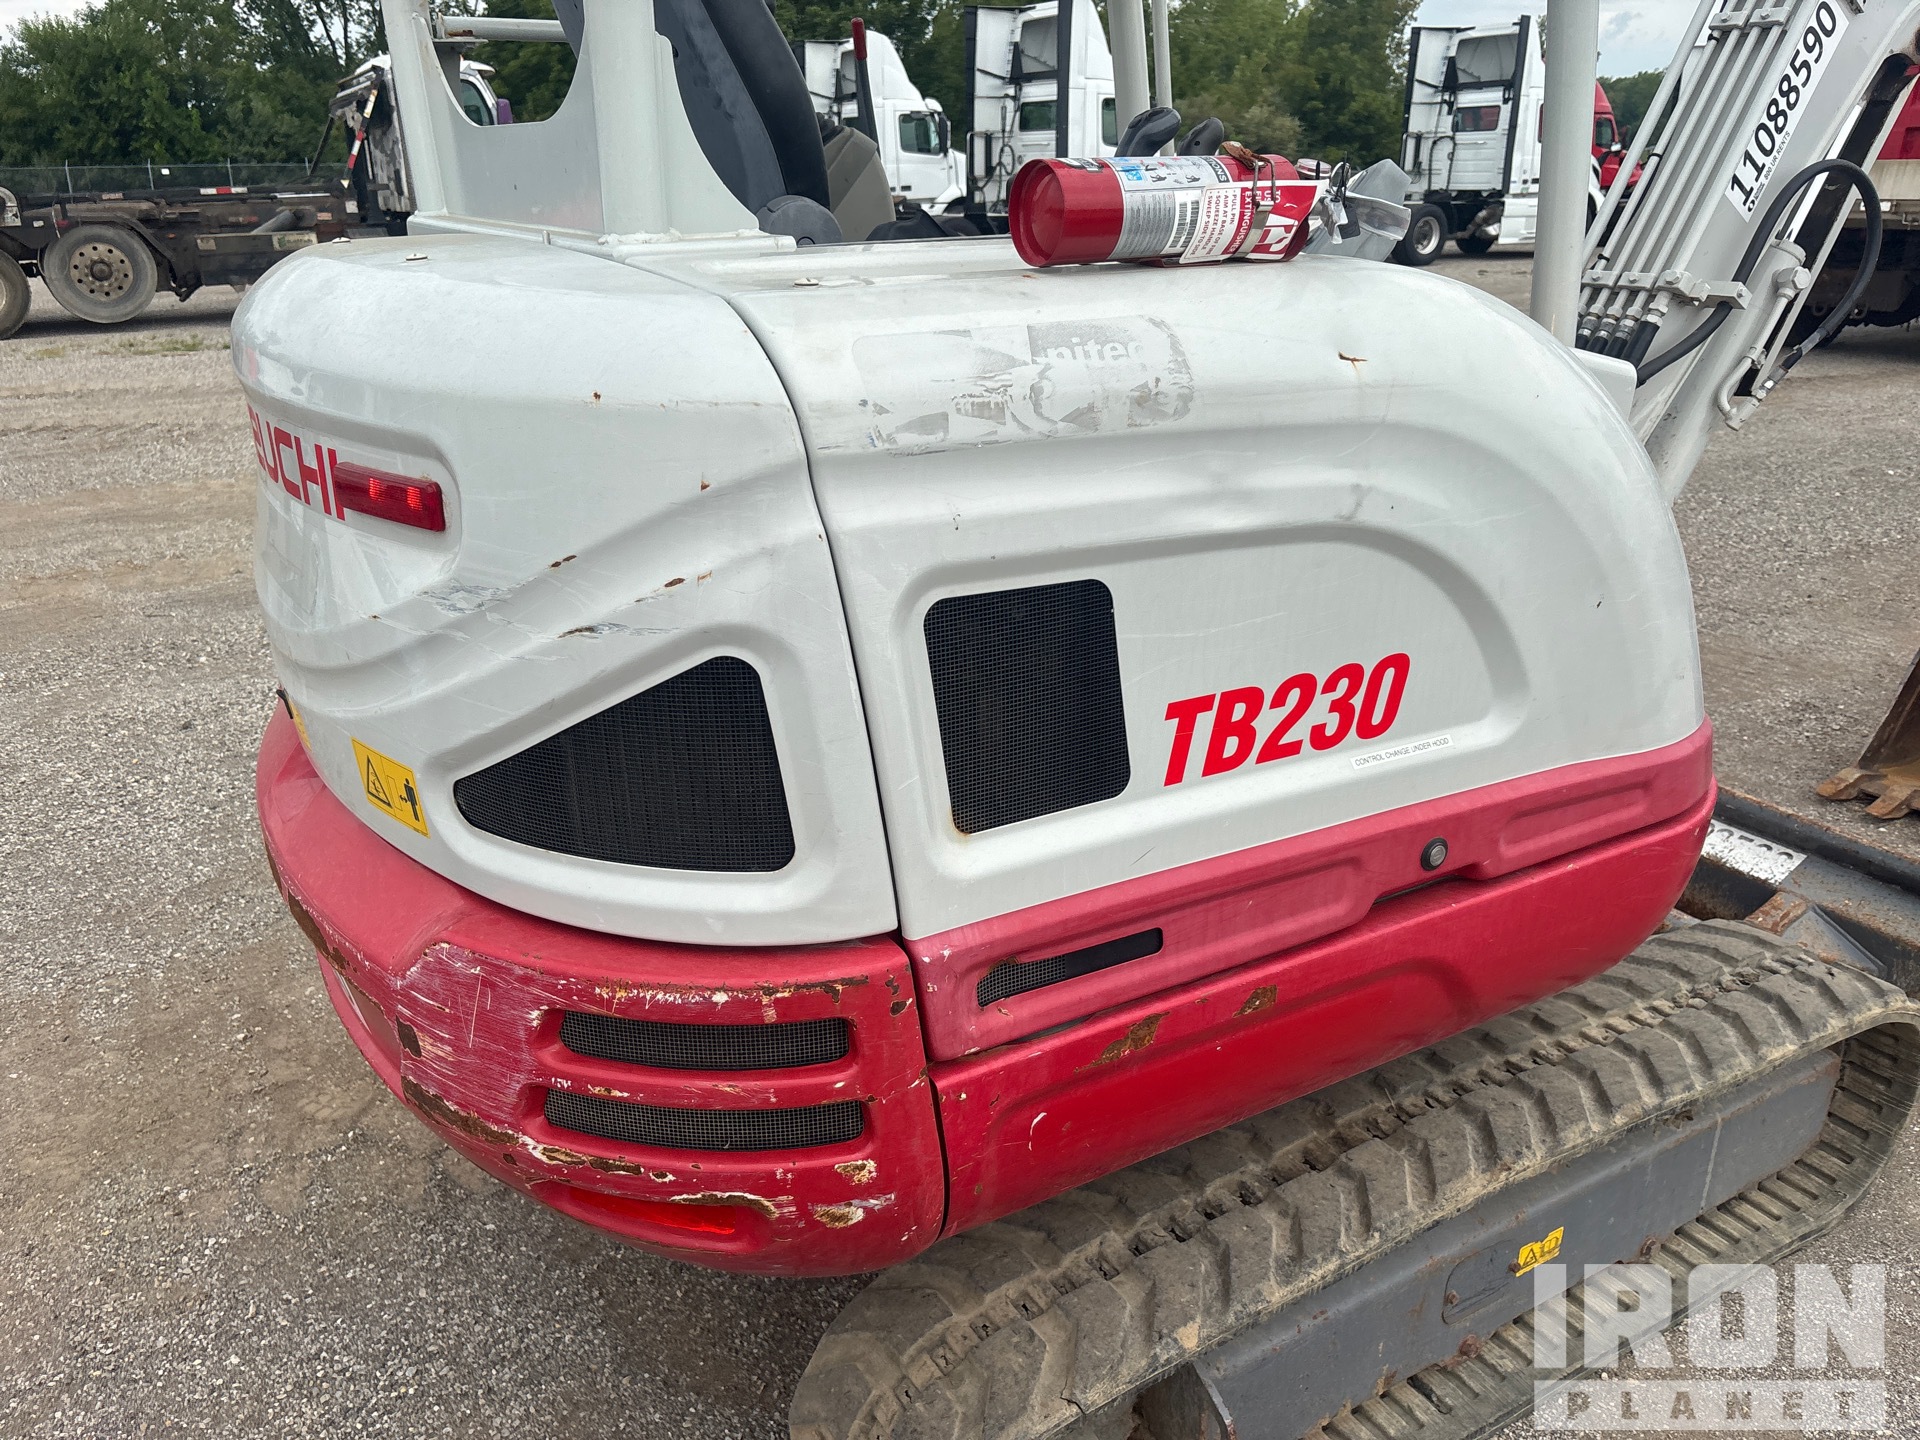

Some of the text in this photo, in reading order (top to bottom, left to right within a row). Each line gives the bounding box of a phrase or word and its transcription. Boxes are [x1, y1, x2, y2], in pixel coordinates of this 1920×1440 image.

[1731, 1, 1836, 207] 1108590
[1764, 131, 1791, 180] 800 UR RENTS
[1213, 195, 1221, 226] SQUEEZE
[1222, 210, 1228, 218] AT
[1230, 191, 1252, 253] EXTINGUISHER
[1201, 220, 1210, 234] SIDE
[1217, 219, 1226, 236] BASE
[1164, 652, 1410, 787] TB230
[1355, 737, 1449, 766] CONTROL CHANGE UNDER HOOD
